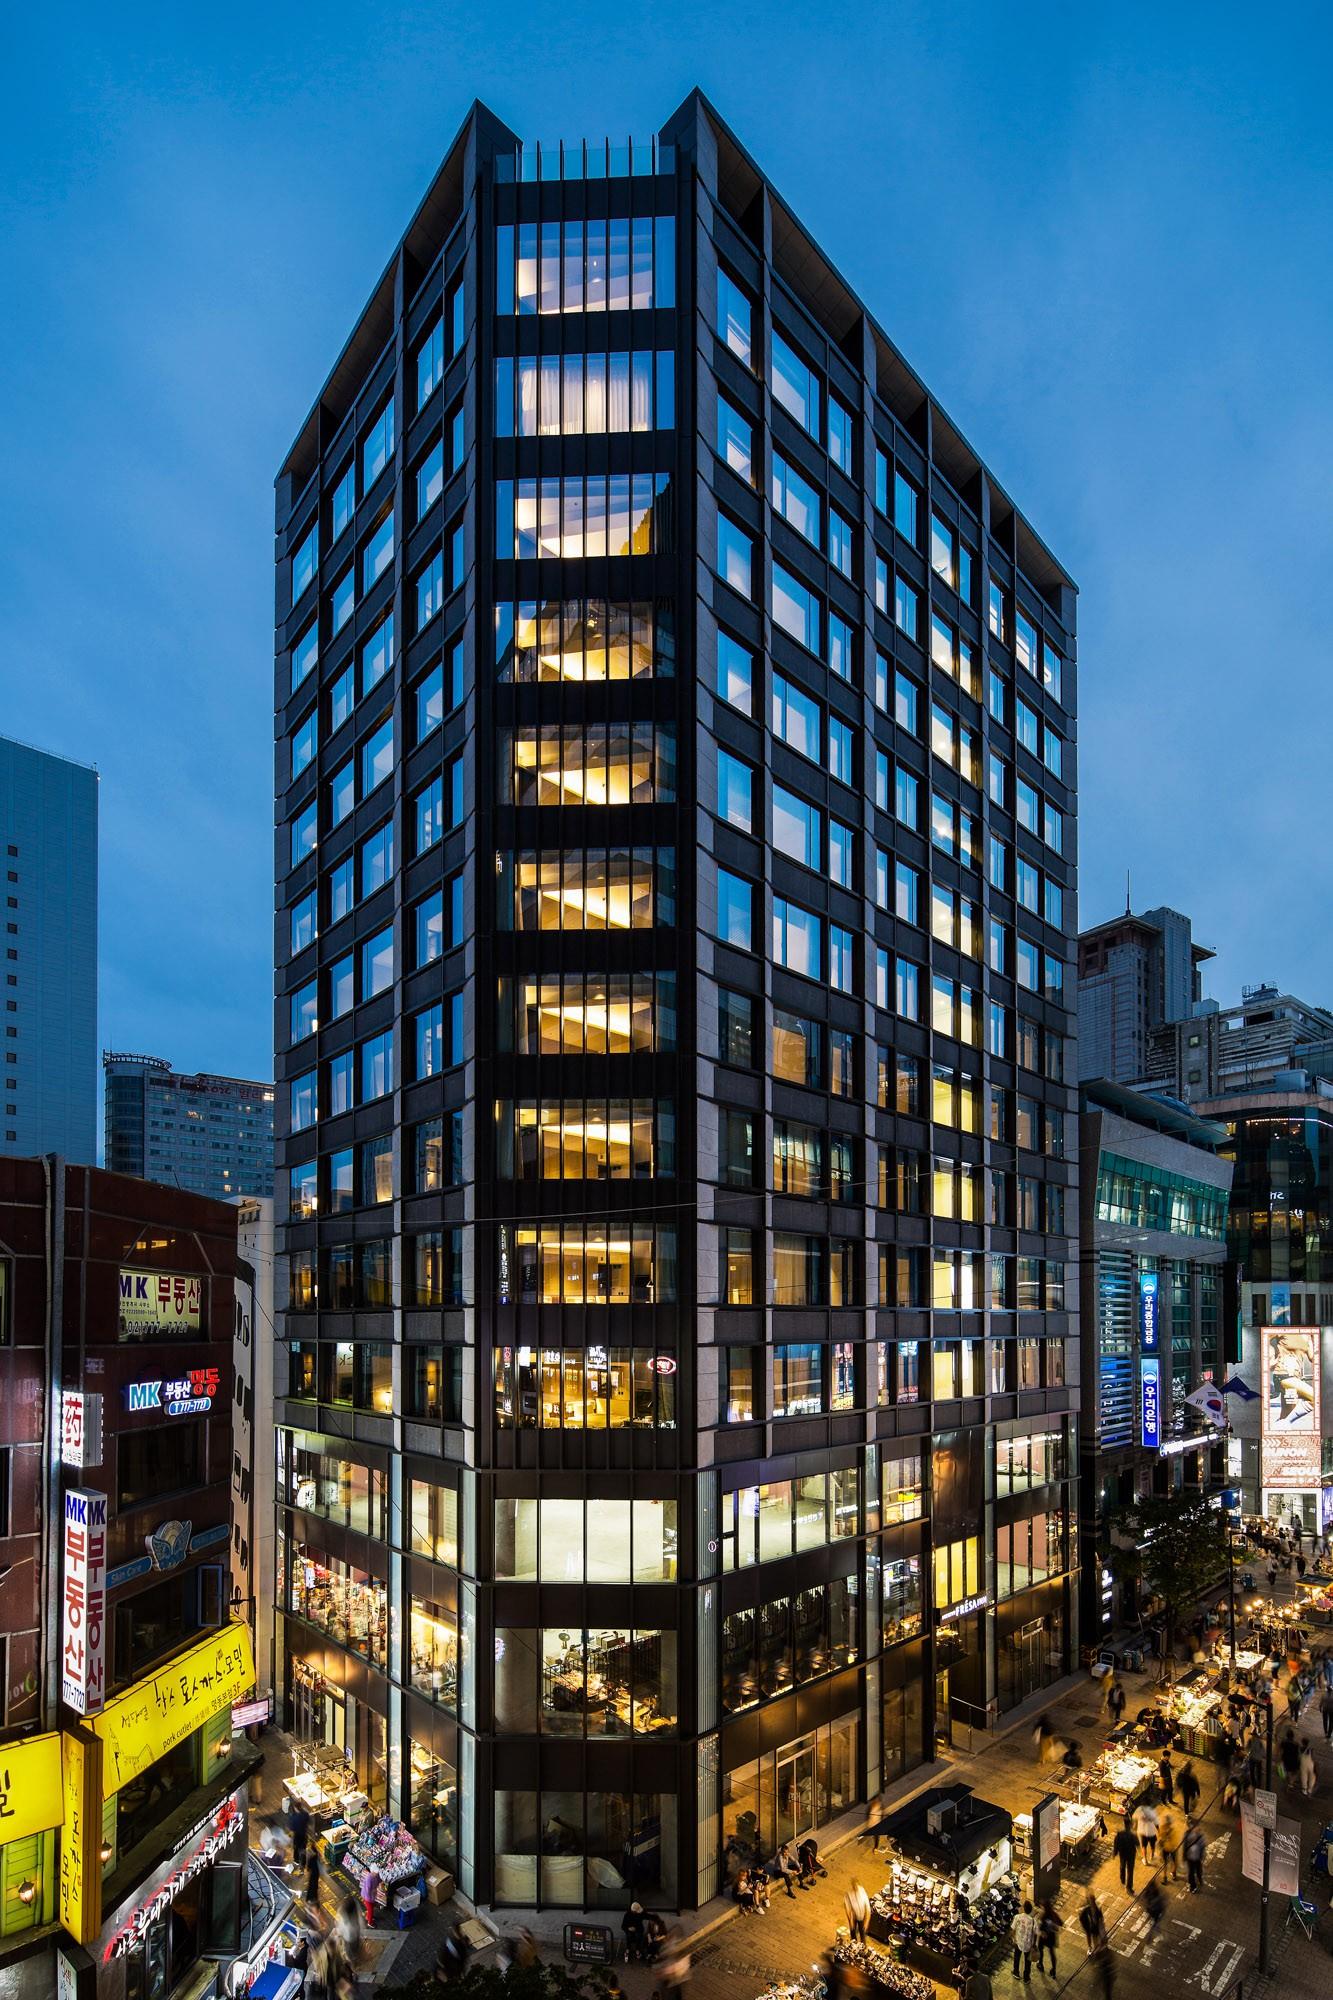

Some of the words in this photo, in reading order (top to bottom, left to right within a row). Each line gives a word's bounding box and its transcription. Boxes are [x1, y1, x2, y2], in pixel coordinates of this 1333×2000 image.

[120, 1274, 148, 1299] MK
[158, 1276, 200, 1315] 부동산
[129, 1381, 162, 1411] MK
[165, 1380, 192, 1400] 부동산
[191, 1368, 220, 1396] 명동
[65, 1397, 82, 1447] 药
[1145, 1386, 1156, 1434] 우리은행
[66, 1494, 87, 1525] MK
[88, 1500, 106, 1526] MK
[65, 1526, 84, 1683] 부동산
[86, 1531, 104, 1710] 부동산
[163, 1733, 177, 1750] pork
[177, 1722, 192, 1738] cutlet
